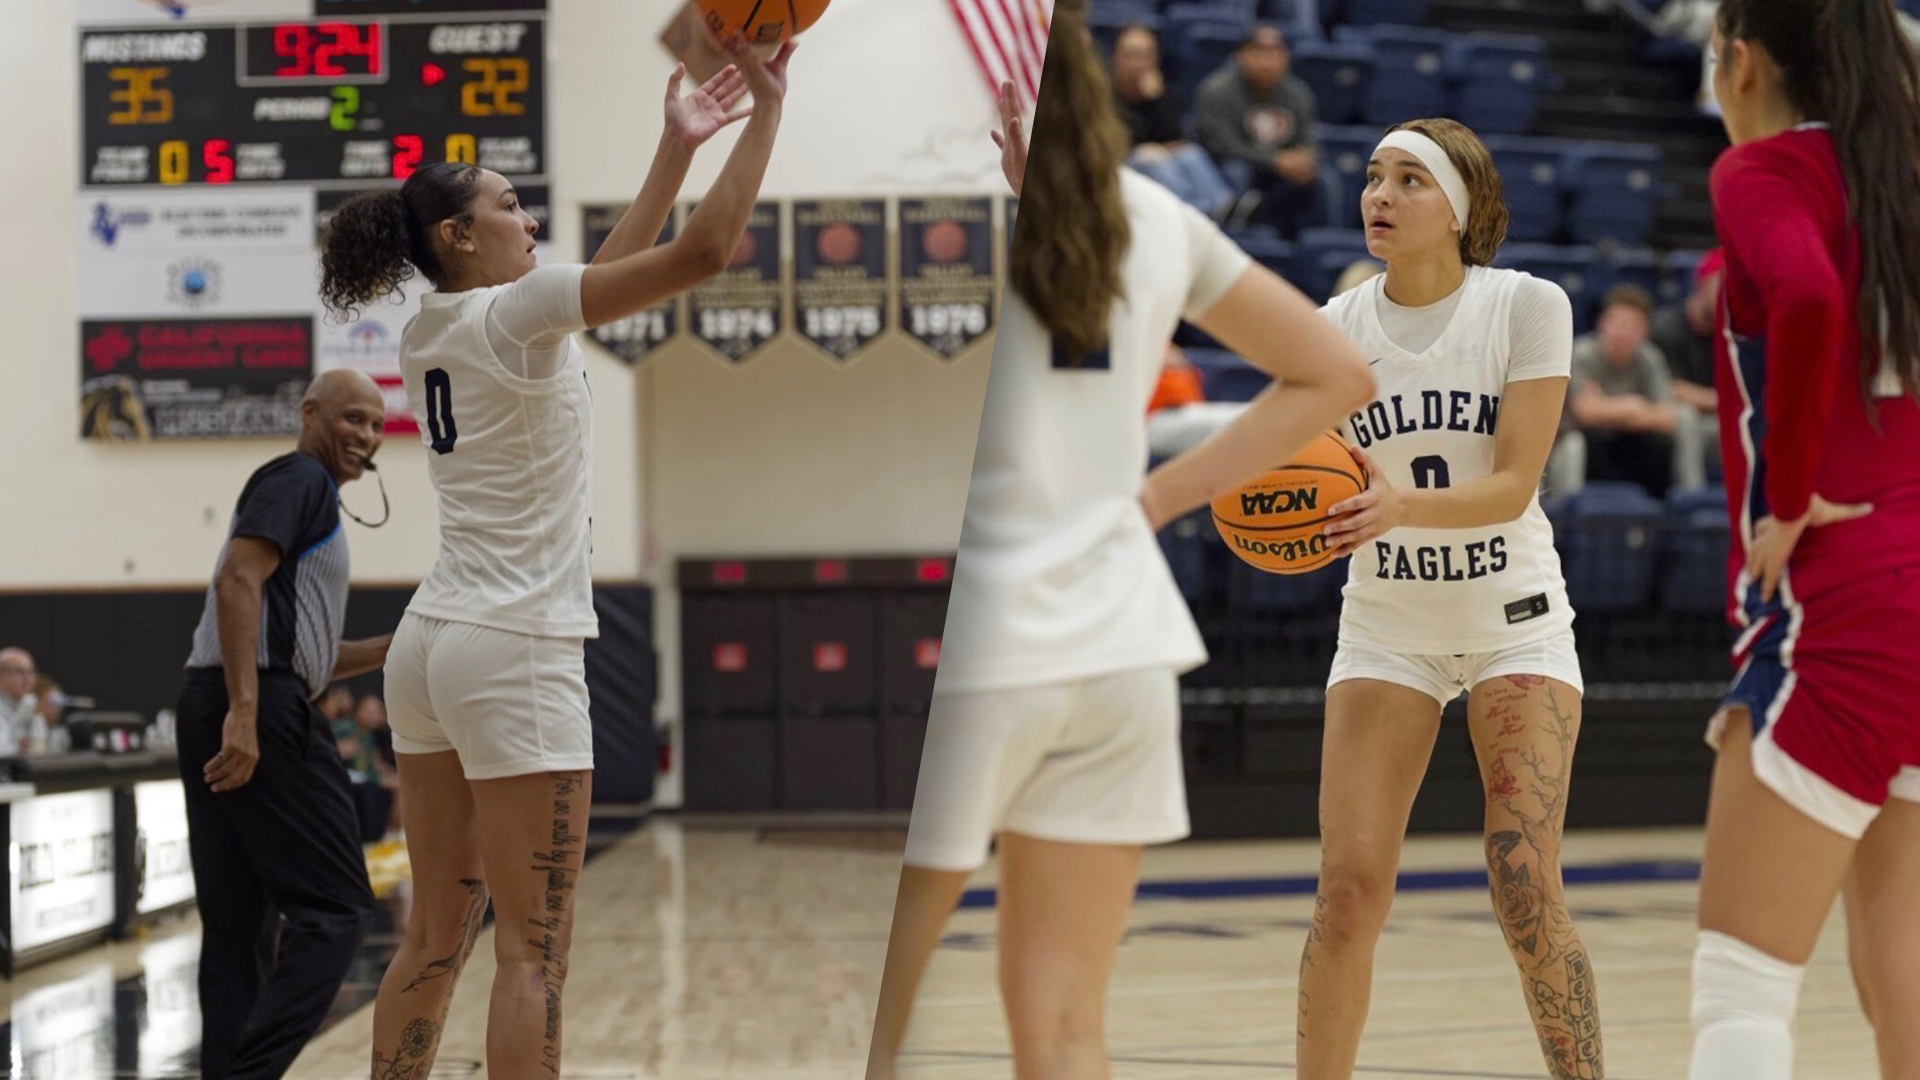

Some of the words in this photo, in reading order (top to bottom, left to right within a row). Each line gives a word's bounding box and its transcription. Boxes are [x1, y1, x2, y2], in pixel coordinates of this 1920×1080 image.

[82, 32, 206, 62] MUSTANGS
[428, 23, 527, 53] GUEST
[106, 67, 174, 124] 35
[460, 58, 530, 117] 22
[253, 97, 330, 120] PERIOD
[329, 85, 360, 130] 2
[158, 140, 189, 185] 0
[203, 138, 233, 184] 5
[393, 134, 423, 180] 2
[701, 307, 776, 340] 1974
[805, 305, 881, 338] 1975
[910, 303, 988, 336] 1976
[425, 367, 458, 455] 0
[1350, 389, 1500, 450] GOLDEN
[1240, 486, 1318, 517] NCAA
[1233, 531, 1332, 562] Wilson
[1375, 535, 1508, 582] EAGLES
[549, 771, 583, 797] For
[554, 799, 570, 815] we
[551, 819, 581, 846] walk
[533, 849, 580, 865] by
[544, 895, 567, 913] not
[528, 917, 568, 932] by
